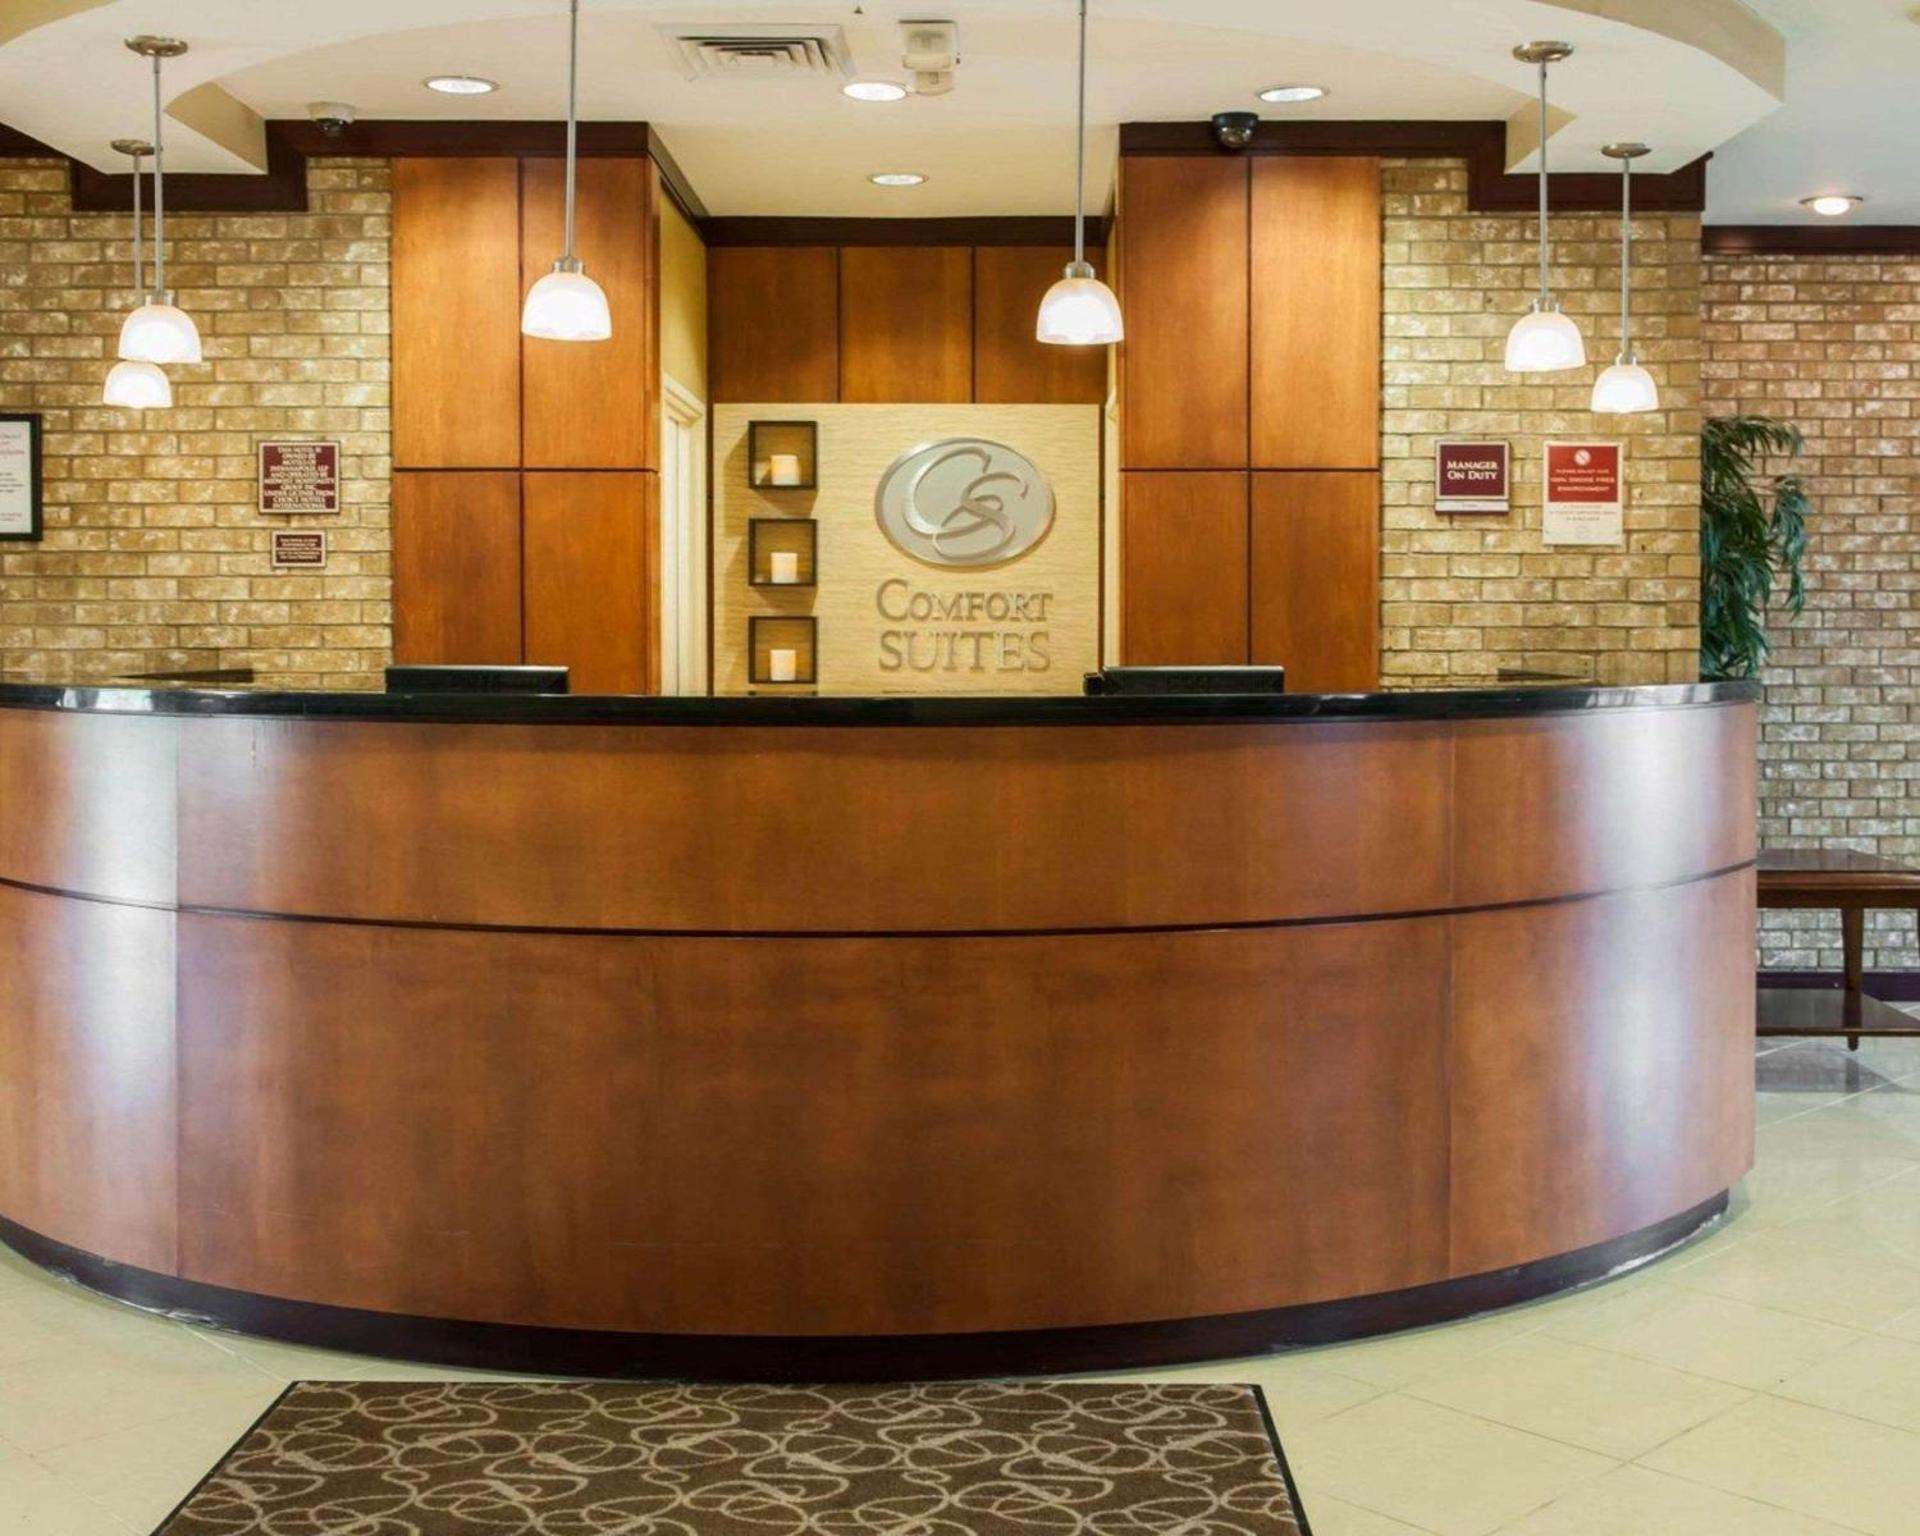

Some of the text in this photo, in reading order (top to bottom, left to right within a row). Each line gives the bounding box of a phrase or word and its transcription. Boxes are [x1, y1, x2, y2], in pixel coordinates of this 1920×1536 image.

[1447, 461, 1498, 470] MANAGER
[1447, 471, 1498, 480] ON DUTY
[876, 578, 1053, 622] COMFORT
[878, 630, 1052, 673] SUITES
